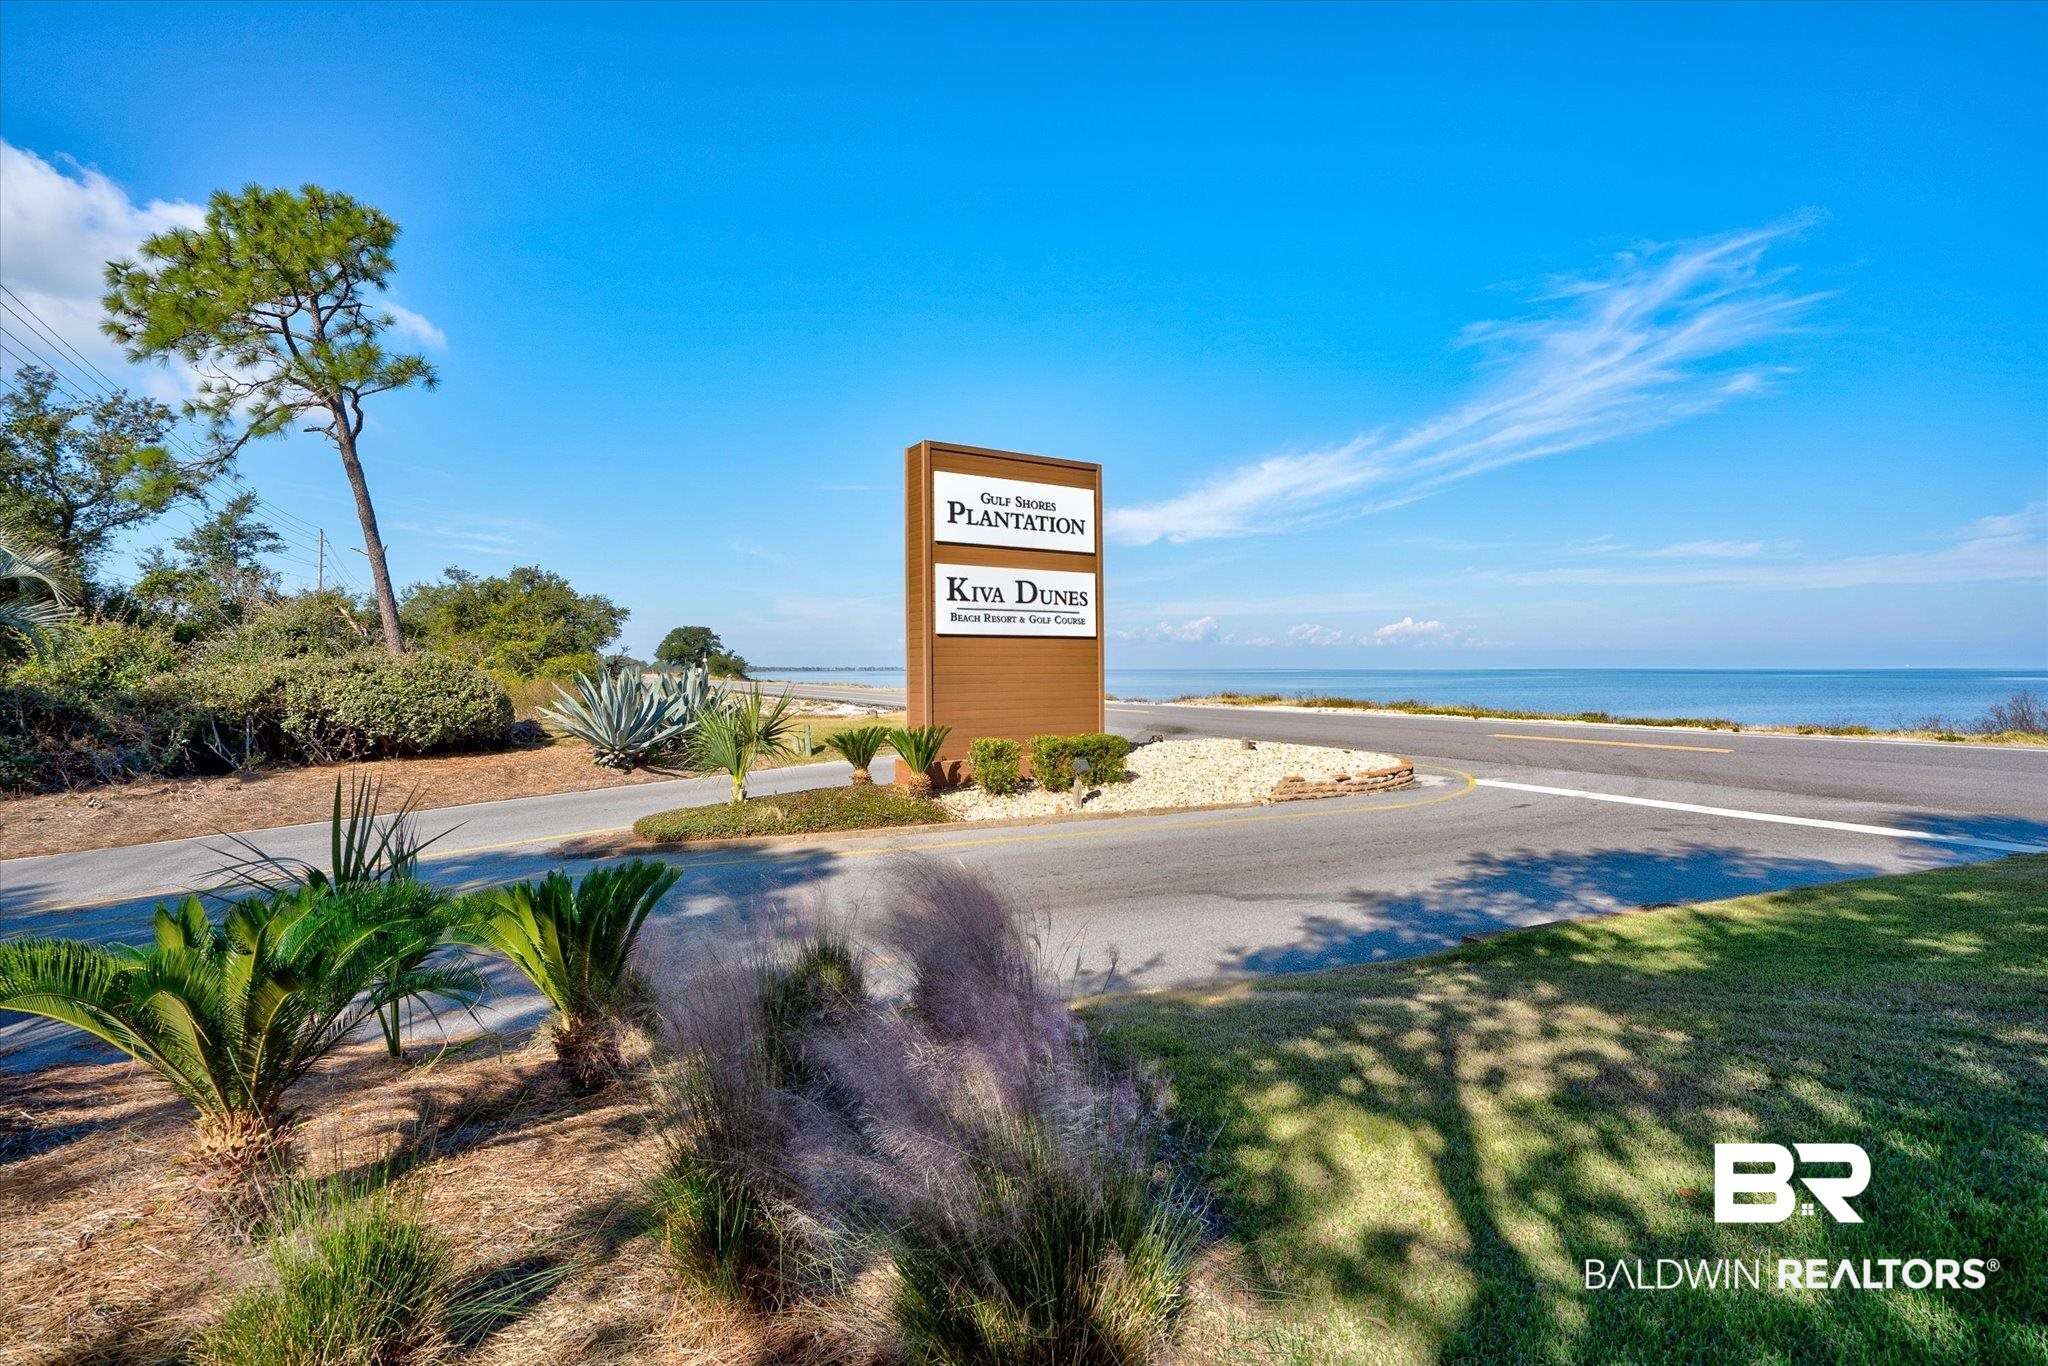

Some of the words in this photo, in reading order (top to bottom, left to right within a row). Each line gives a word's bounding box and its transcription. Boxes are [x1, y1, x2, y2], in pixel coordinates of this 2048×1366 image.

[980, 492, 1011, 507] GULF
[1015, 496, 1057, 511] SHORES
[947, 500, 1086, 535] PLANTATION
[946, 576, 1006, 604] KIVA
[1015, 580, 1088, 606] DUNES
[950, 613, 981, 623] BEACH
[984, 614, 1017, 623] RESORT
[1029, 614, 1052, 624] GOLF
[1054, 615, 1086, 625] COURSE
